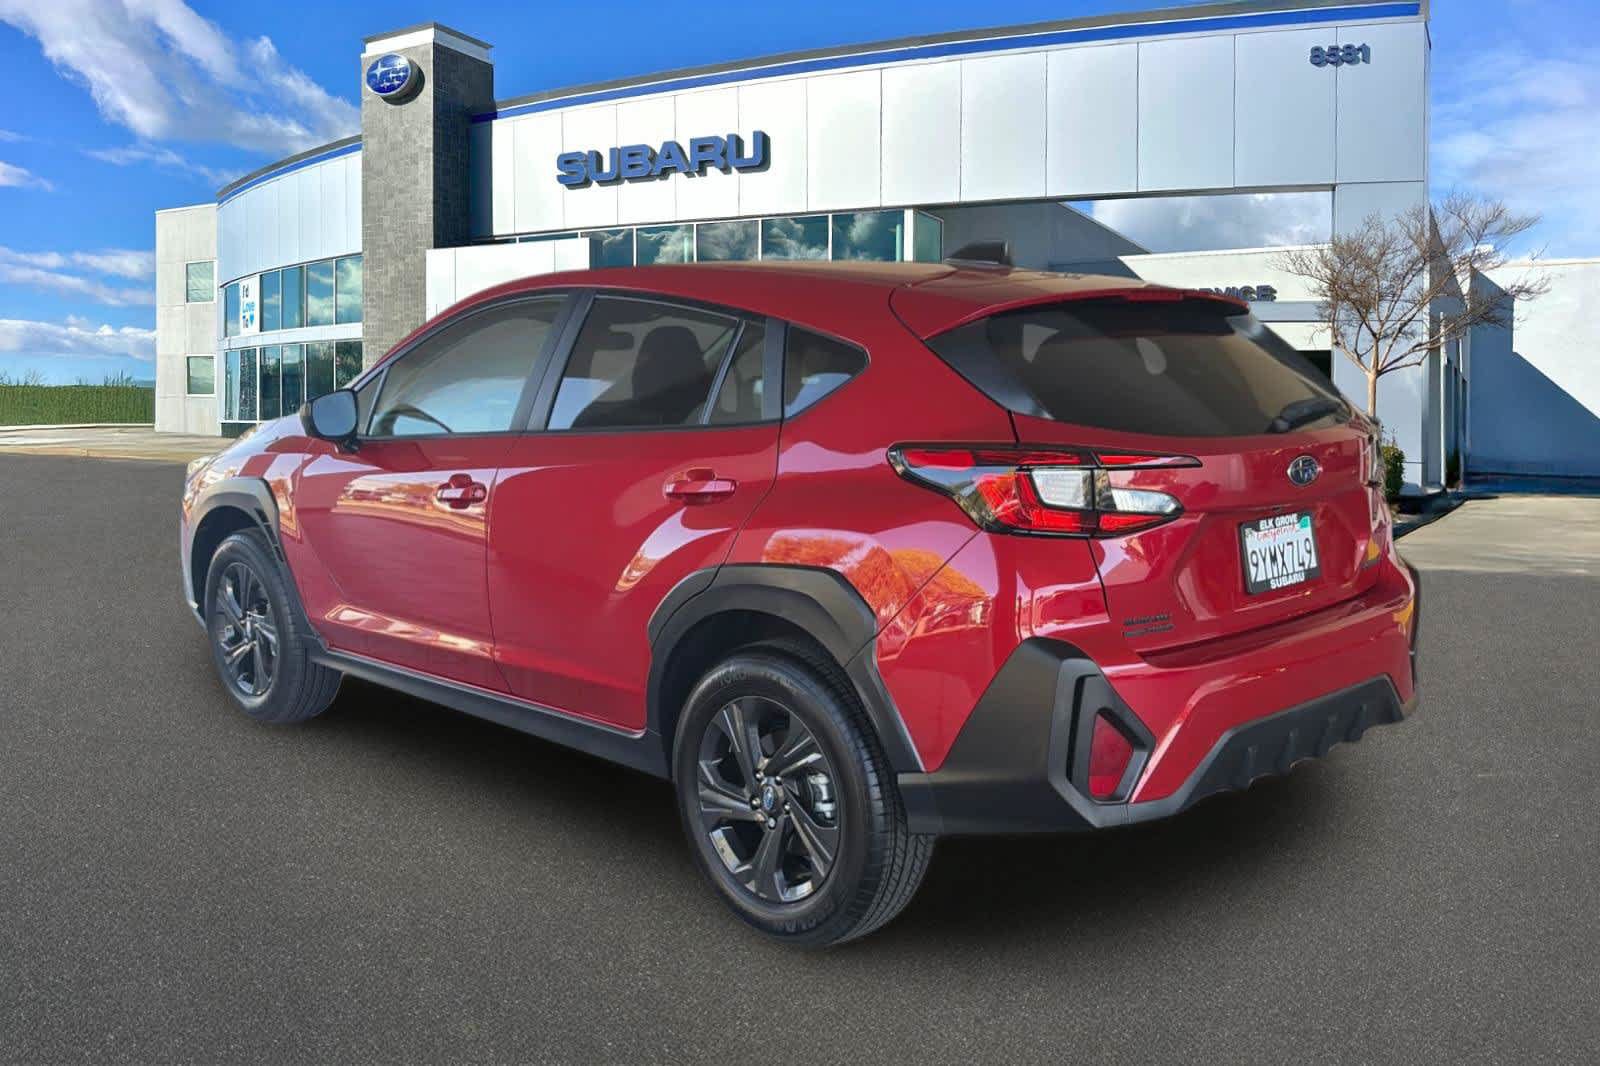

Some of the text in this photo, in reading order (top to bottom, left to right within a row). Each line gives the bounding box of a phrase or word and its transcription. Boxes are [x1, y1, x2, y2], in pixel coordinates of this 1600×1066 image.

[556, 130, 771, 190] SUBARU
[1260, 513, 1298, 530] ELK GROVE
[1270, 571, 1305, 589] SUBARU
